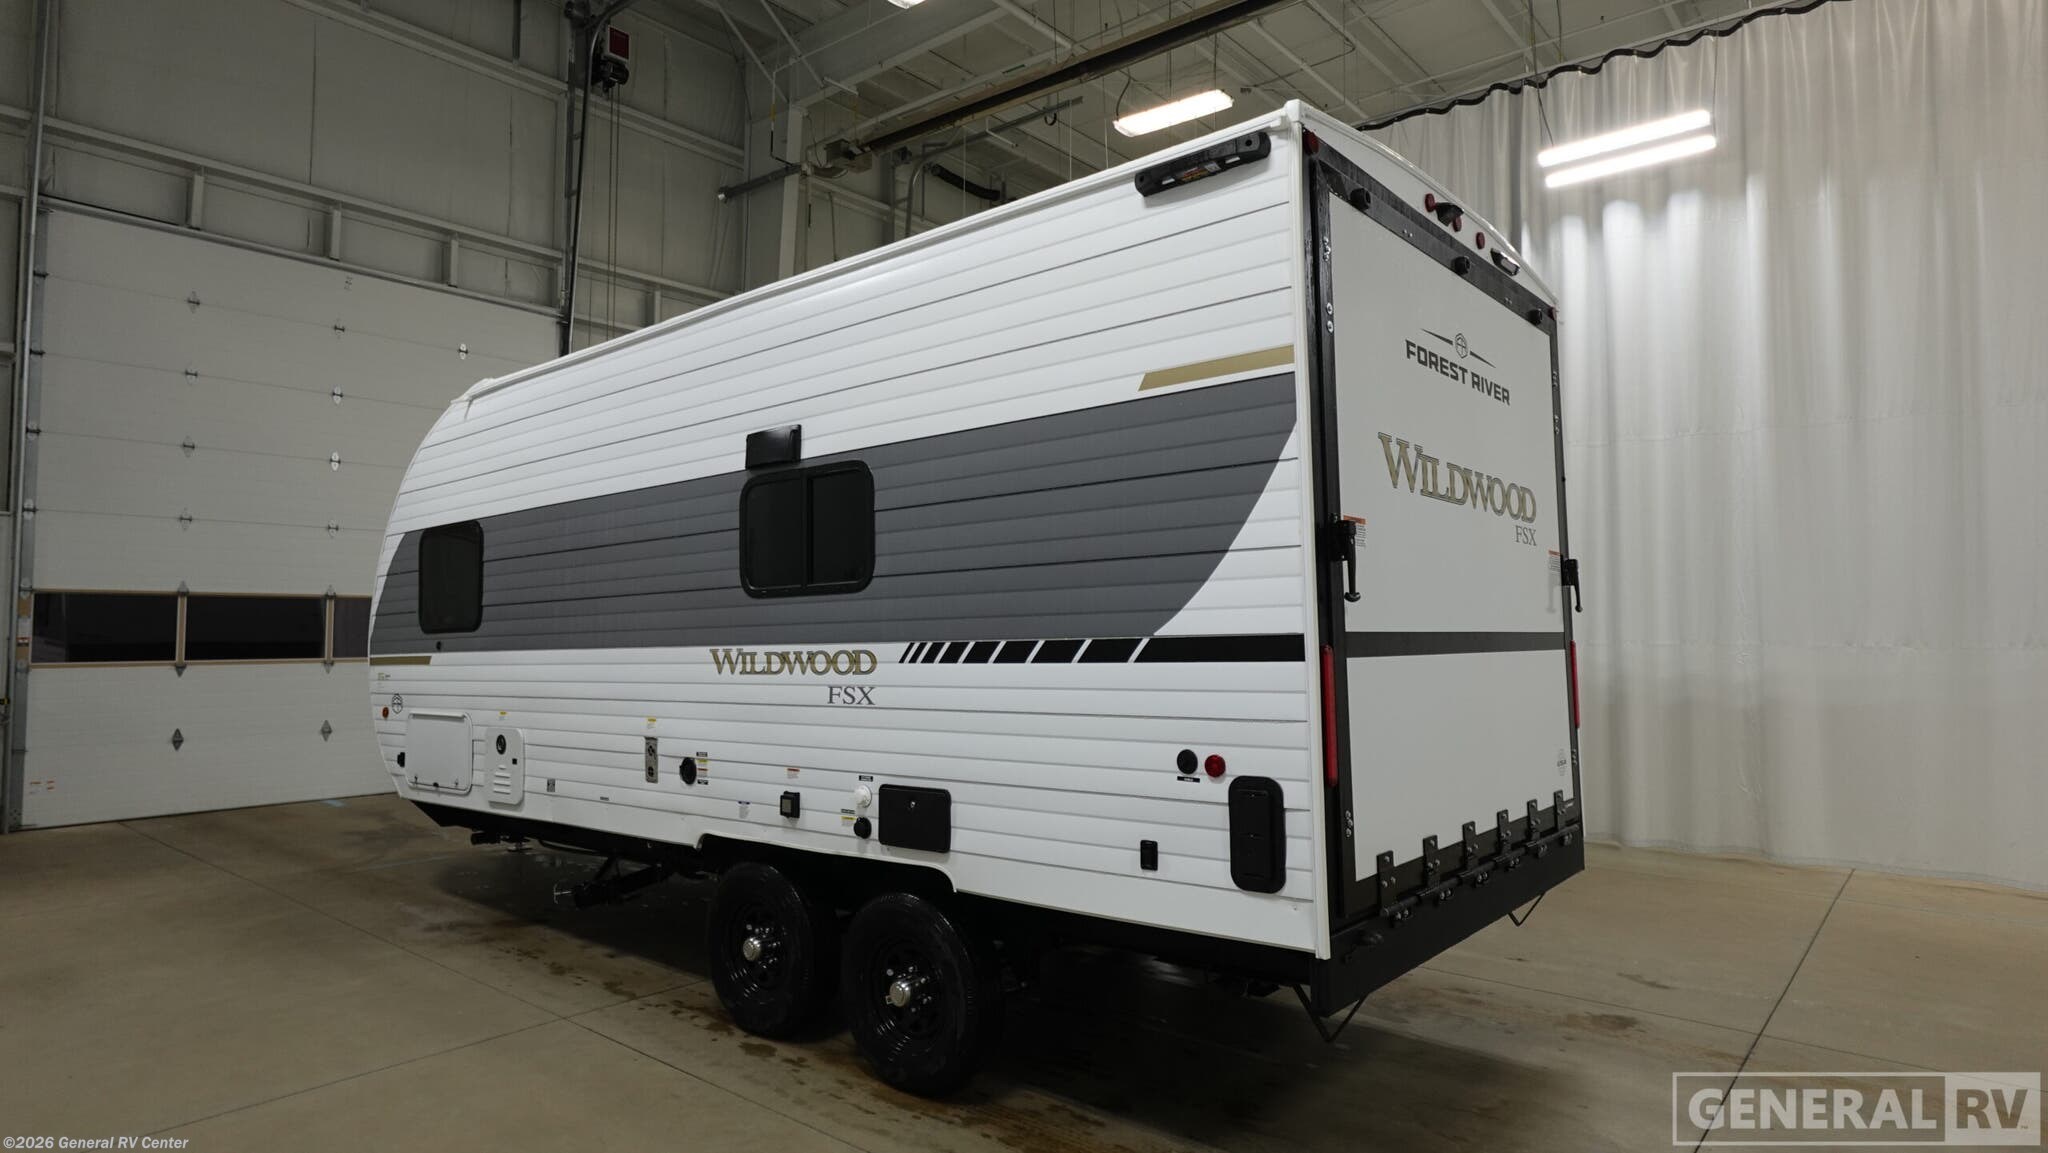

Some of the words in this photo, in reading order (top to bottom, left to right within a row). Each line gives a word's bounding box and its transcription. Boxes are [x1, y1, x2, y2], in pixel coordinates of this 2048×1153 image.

[1405, 339, 1468, 384] FOREST
[1470, 371, 1511, 406] RIVER
[1377, 431, 1537, 524] WILDWOOD
[1515, 525, 1537, 546] FSX
[709, 648, 878, 676] WILDWOOD
[827, 685, 877, 706] FSX
